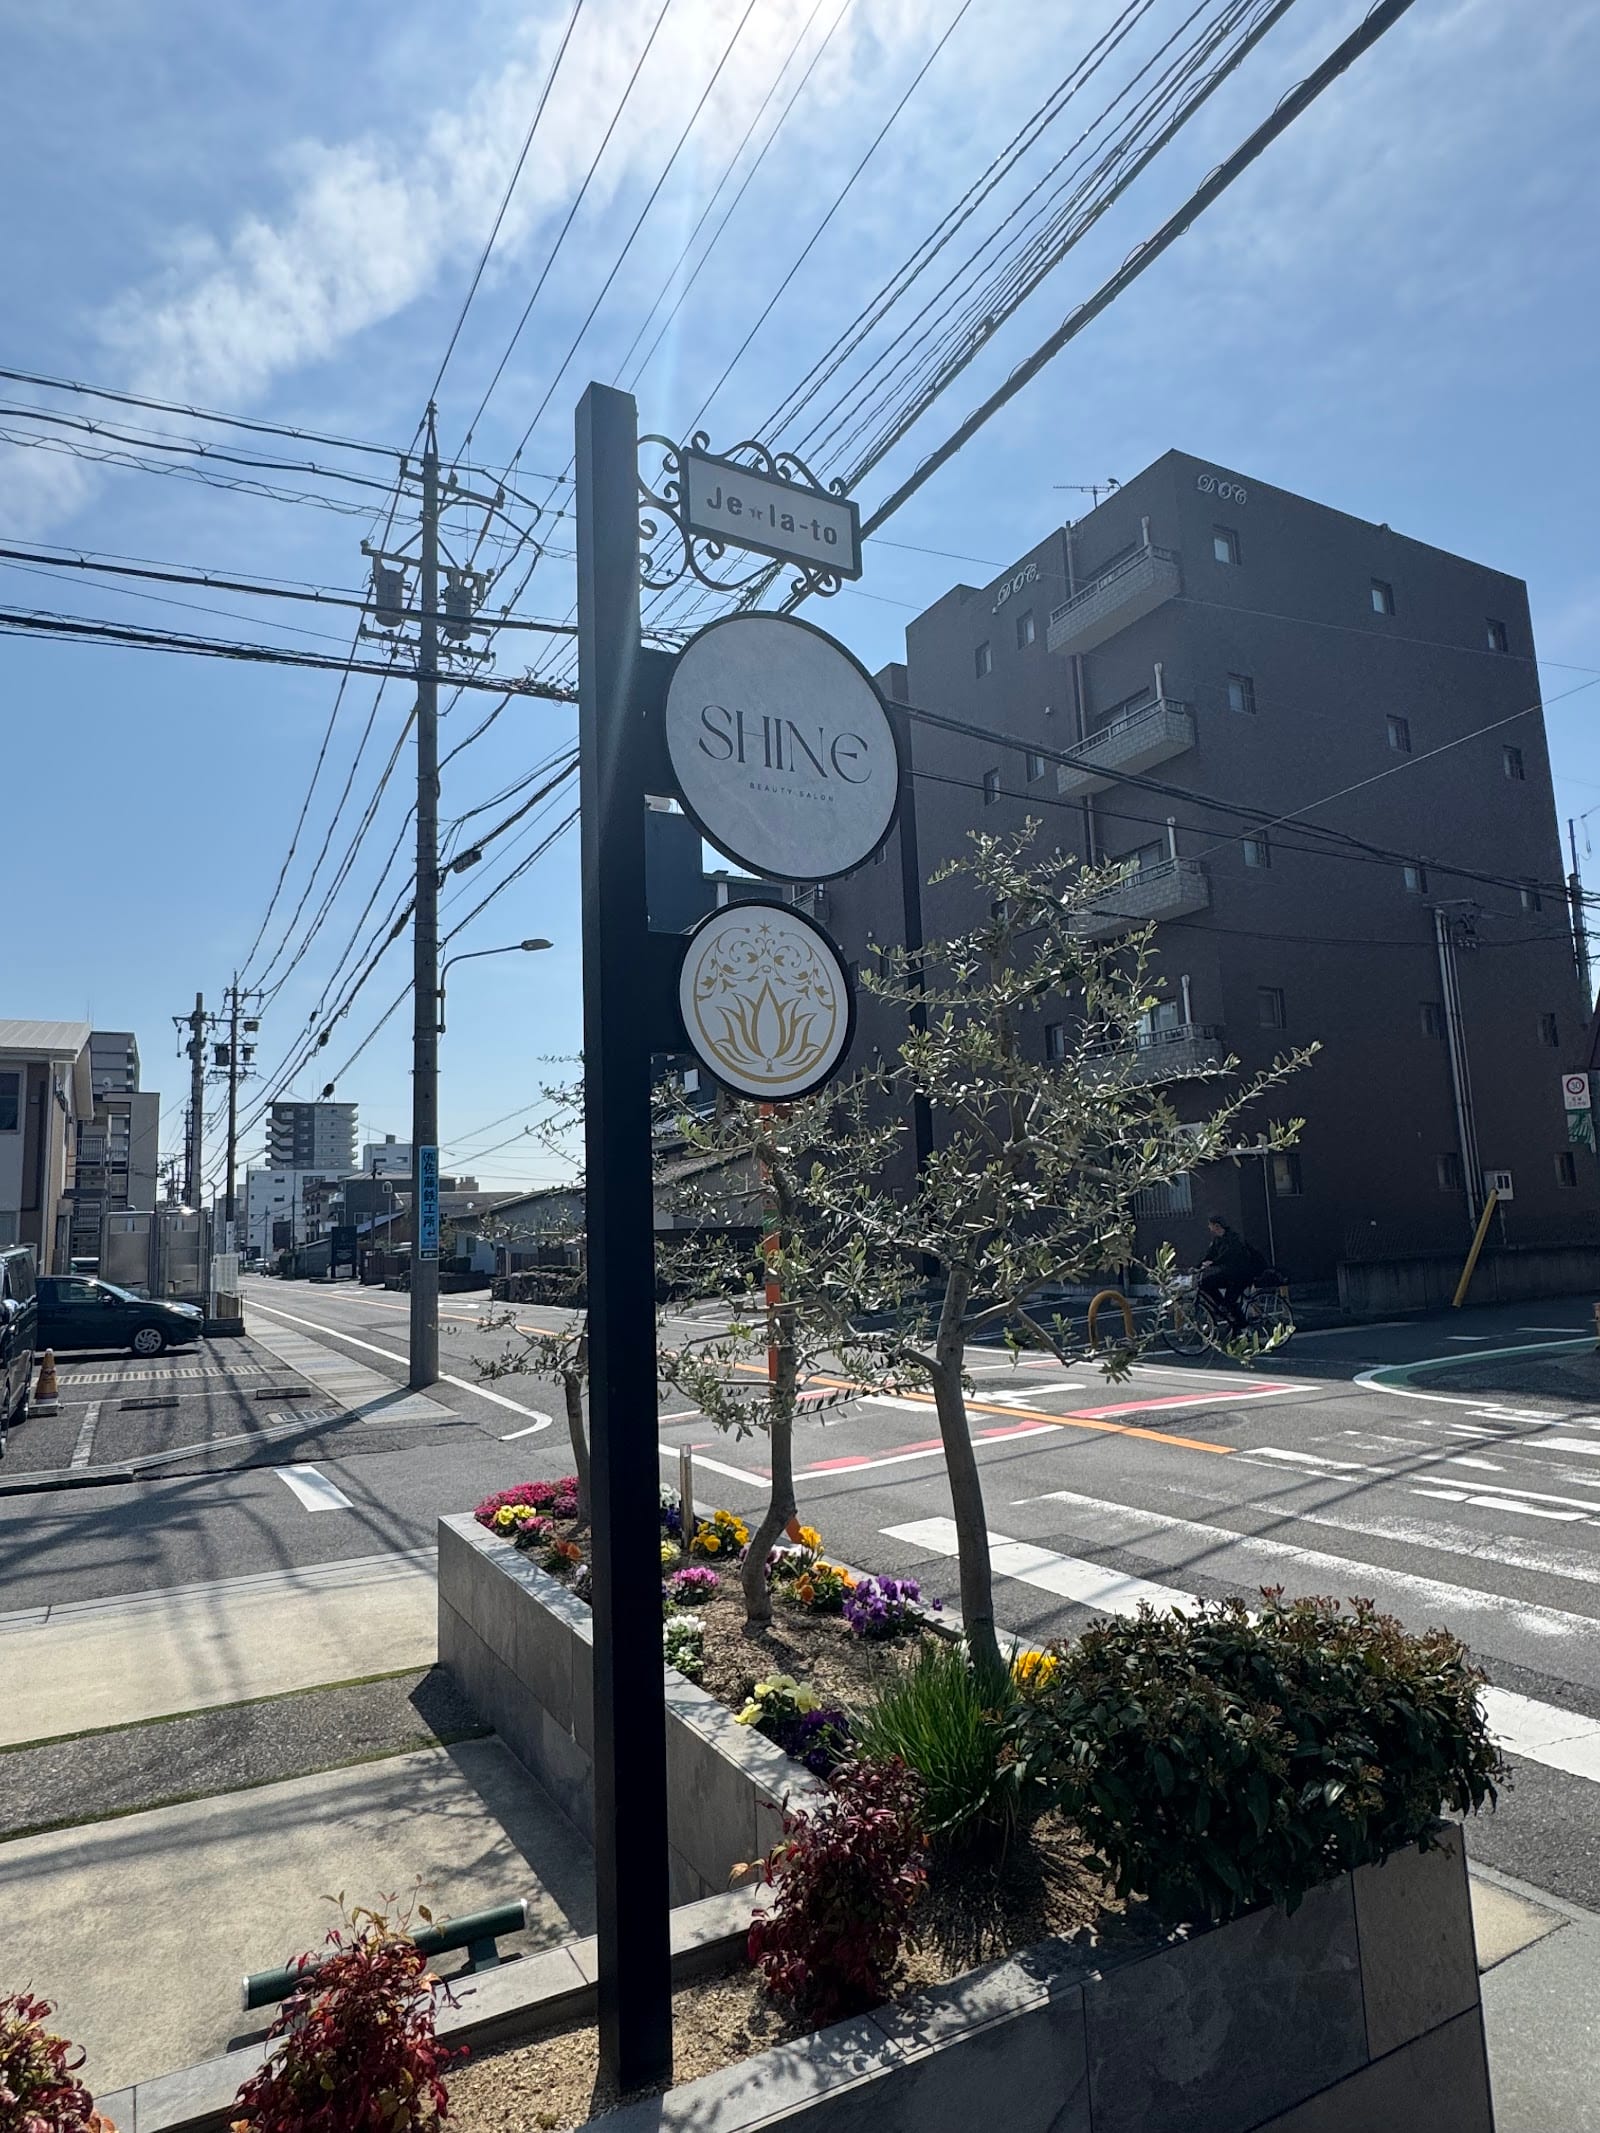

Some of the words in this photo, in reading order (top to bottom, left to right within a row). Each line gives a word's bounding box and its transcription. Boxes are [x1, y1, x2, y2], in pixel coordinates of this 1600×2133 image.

[699, 705, 872, 783] SHINE
[749, 782, 792, 795] BEAUTY
[799, 790, 834, 802] SALON
[1571, 1081, 1581, 1090] 30
